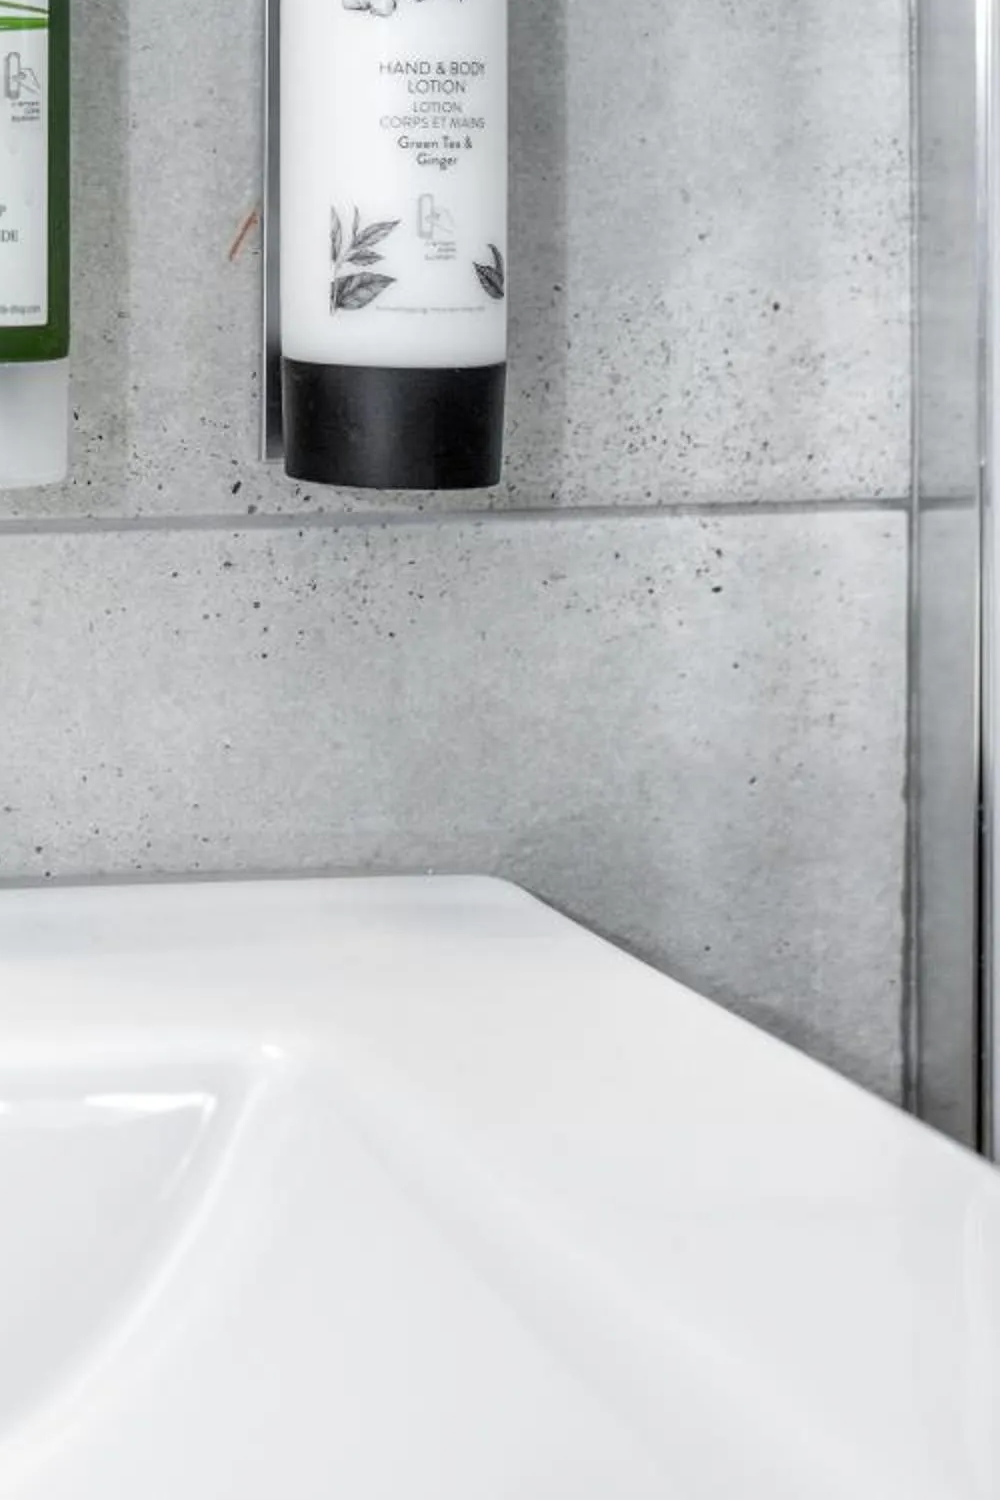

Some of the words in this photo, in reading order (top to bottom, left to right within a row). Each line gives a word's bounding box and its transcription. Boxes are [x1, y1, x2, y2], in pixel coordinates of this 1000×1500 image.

[379, 61, 431, 75] HAND
[435, 62, 446, 75] &
[450, 61, 486, 76] BODY
[407, 79, 466, 94] LOTION
[412, 101, 463, 113] LOTION
[379, 116, 429, 129] CORPS
[431, 116, 447, 129] ET
[397, 135, 438, 149] Green
[442, 135, 461, 149] Tea
[464, 135, 473, 149] &
[416, 152, 457, 171] Ginger
